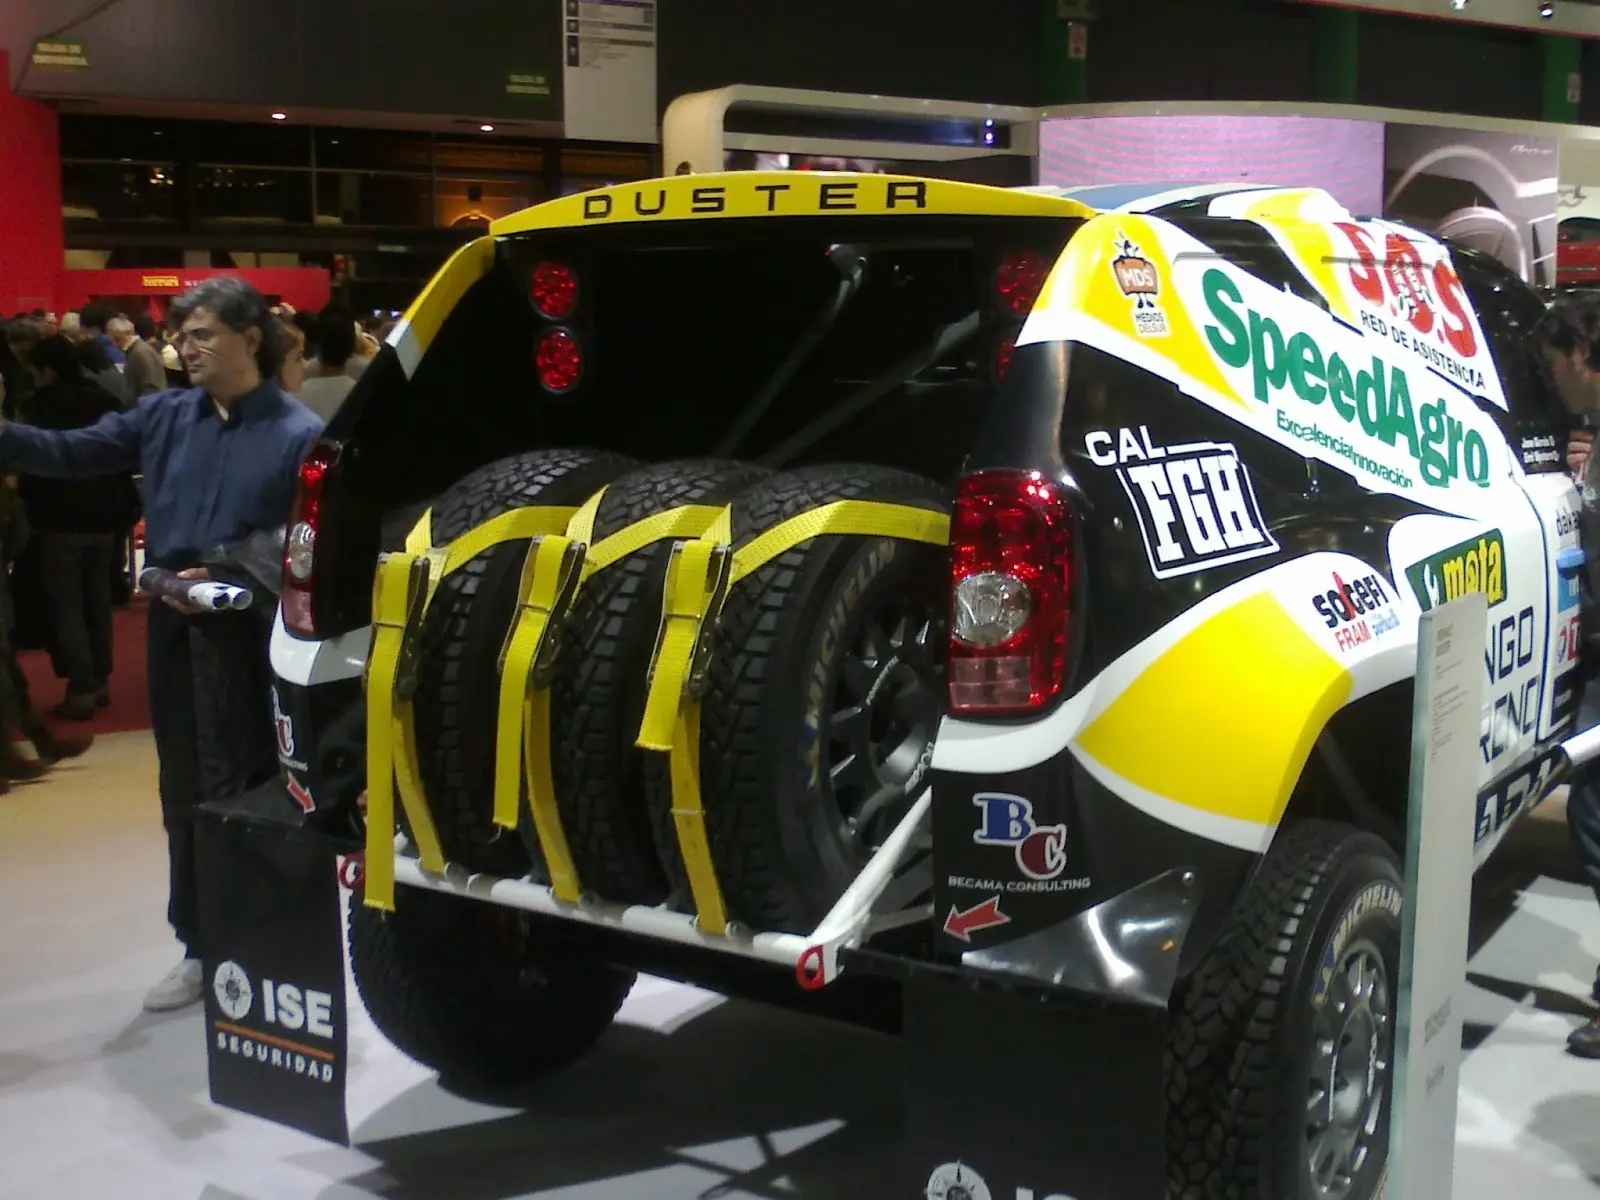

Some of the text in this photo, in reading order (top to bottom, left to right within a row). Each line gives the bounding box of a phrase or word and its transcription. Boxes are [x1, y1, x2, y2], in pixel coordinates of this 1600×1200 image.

[583, 181, 927, 221] DUSTER
[1122, 266, 1155, 288] MDS
[1360, 308, 1487, 391] RED DE ASISTENCIA
[1201, 267, 1491, 489] SpeedAgro
[1084, 424, 1167, 467] CAL
[1126, 453, 1266, 564] FGH
[1334, 619, 1373, 653] FRAM
[948, 874, 1092, 893] BECAMA CONSULTING
[262, 977, 334, 1040] ISE
[216, 1031, 334, 1084] SEGURIDAD
